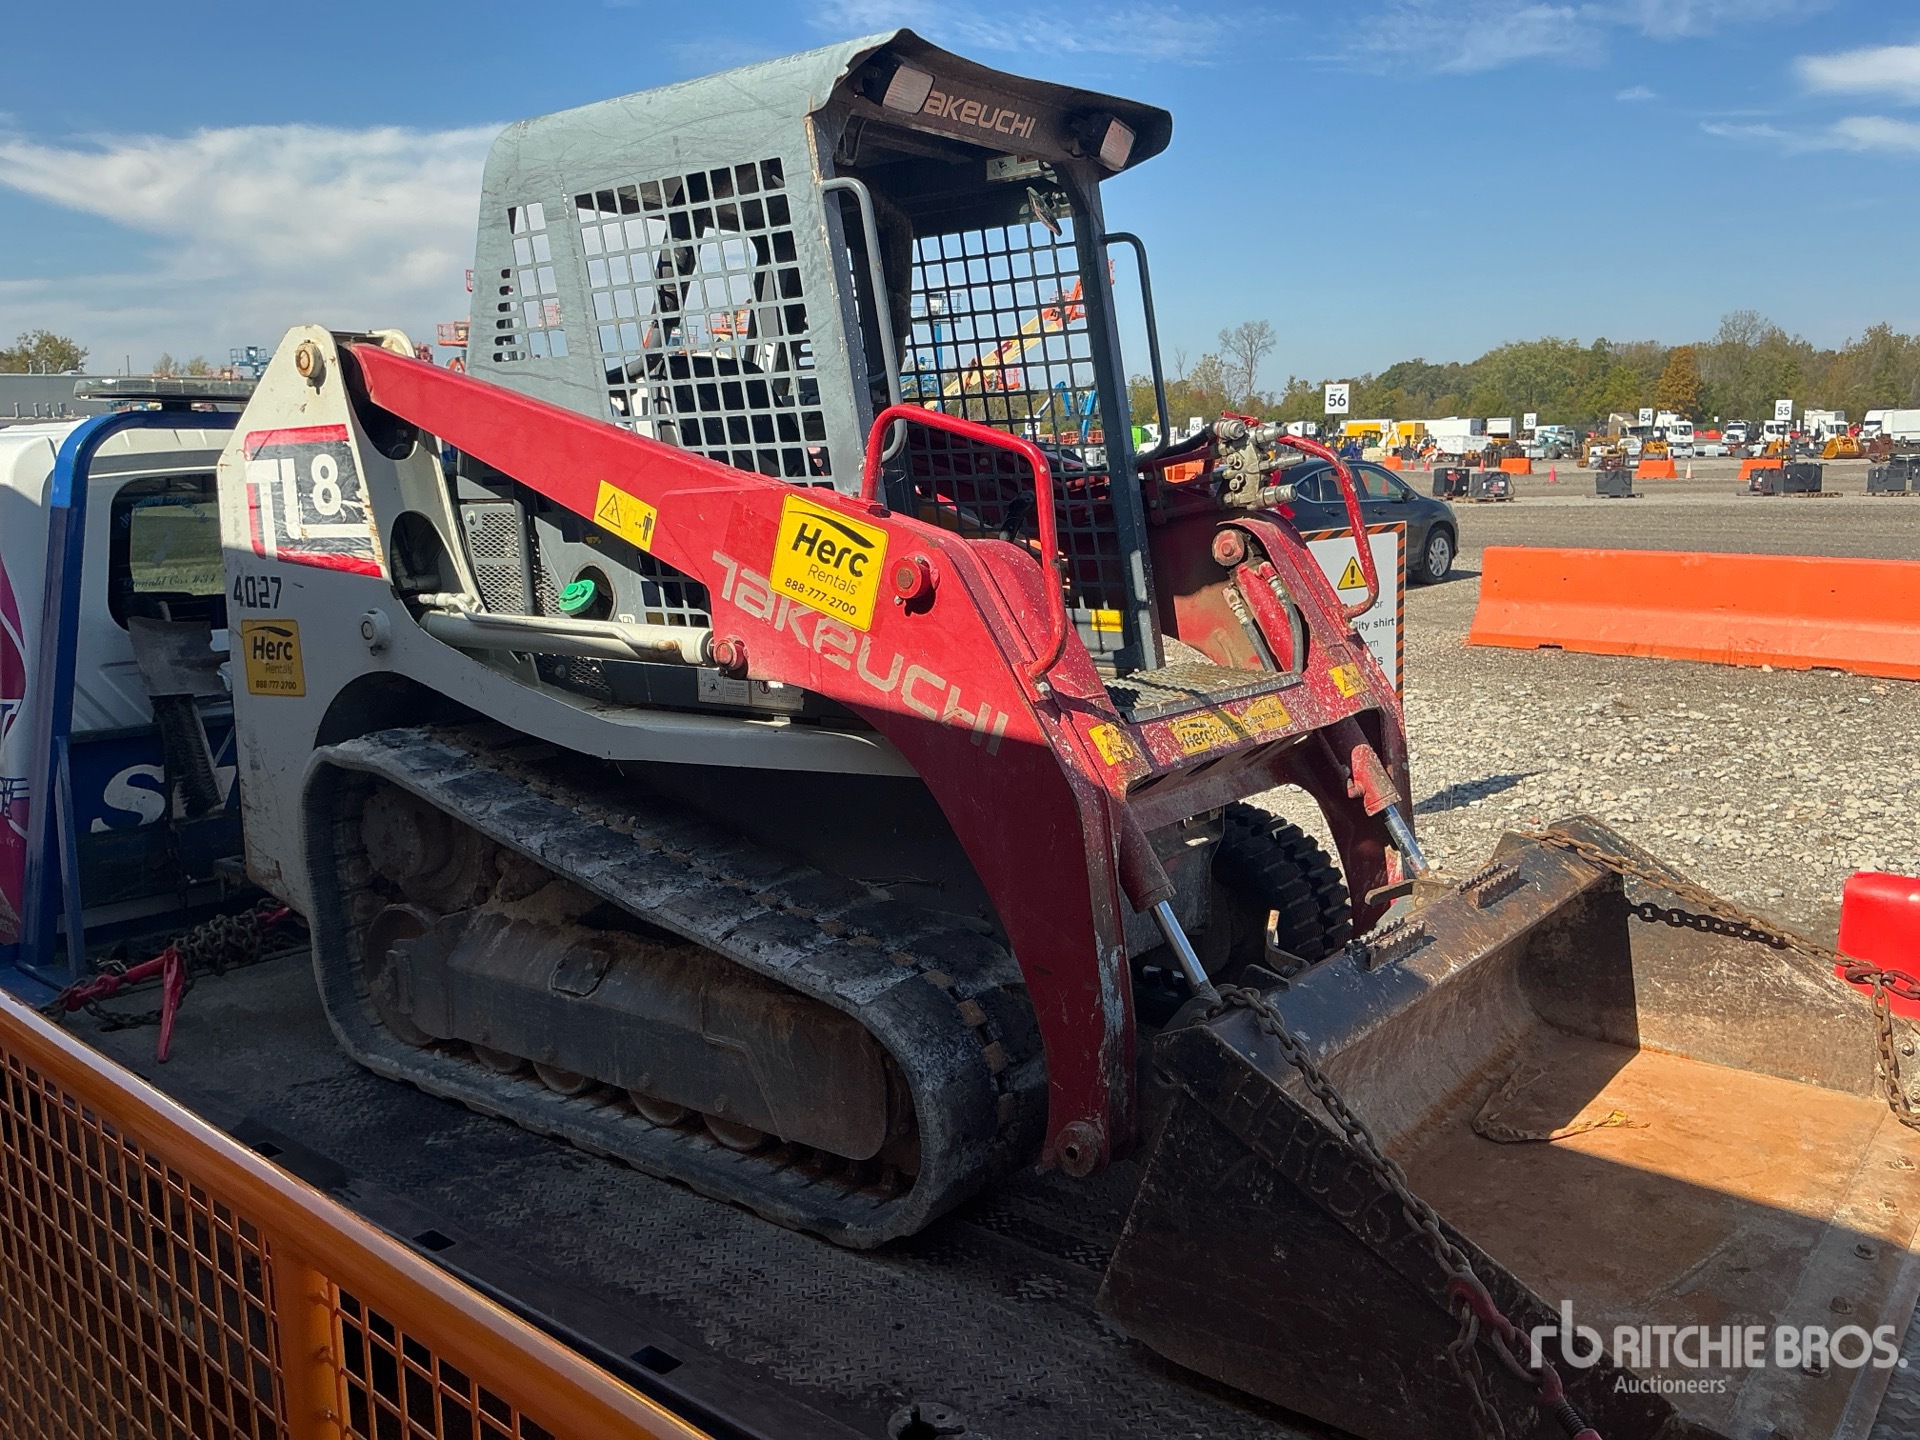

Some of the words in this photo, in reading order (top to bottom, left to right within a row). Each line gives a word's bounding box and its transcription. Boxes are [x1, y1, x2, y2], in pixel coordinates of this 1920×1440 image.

[1328, 393, 1347, 407] 56
[1640, 413, 1651, 422] 54
[1777, 406, 1790, 416] 55
[1190, 423, 1201, 431] 65
[1525, 418, 1535, 426] 53
[245, 453, 371, 558] TL8
[791, 522, 869, 578] Herc
[808, 563, 858, 595] Rentals
[233, 575, 282, 609] 4027
[785, 577, 857, 616] 888-777-2700
[1373, 617, 1395, 629] shirt
[252, 636, 294, 661] Herc
[265, 662, 294, 675] Rentals
[255, 680, 297, 690] 888-777-2700
[1181, 728, 1211, 749] Herc
